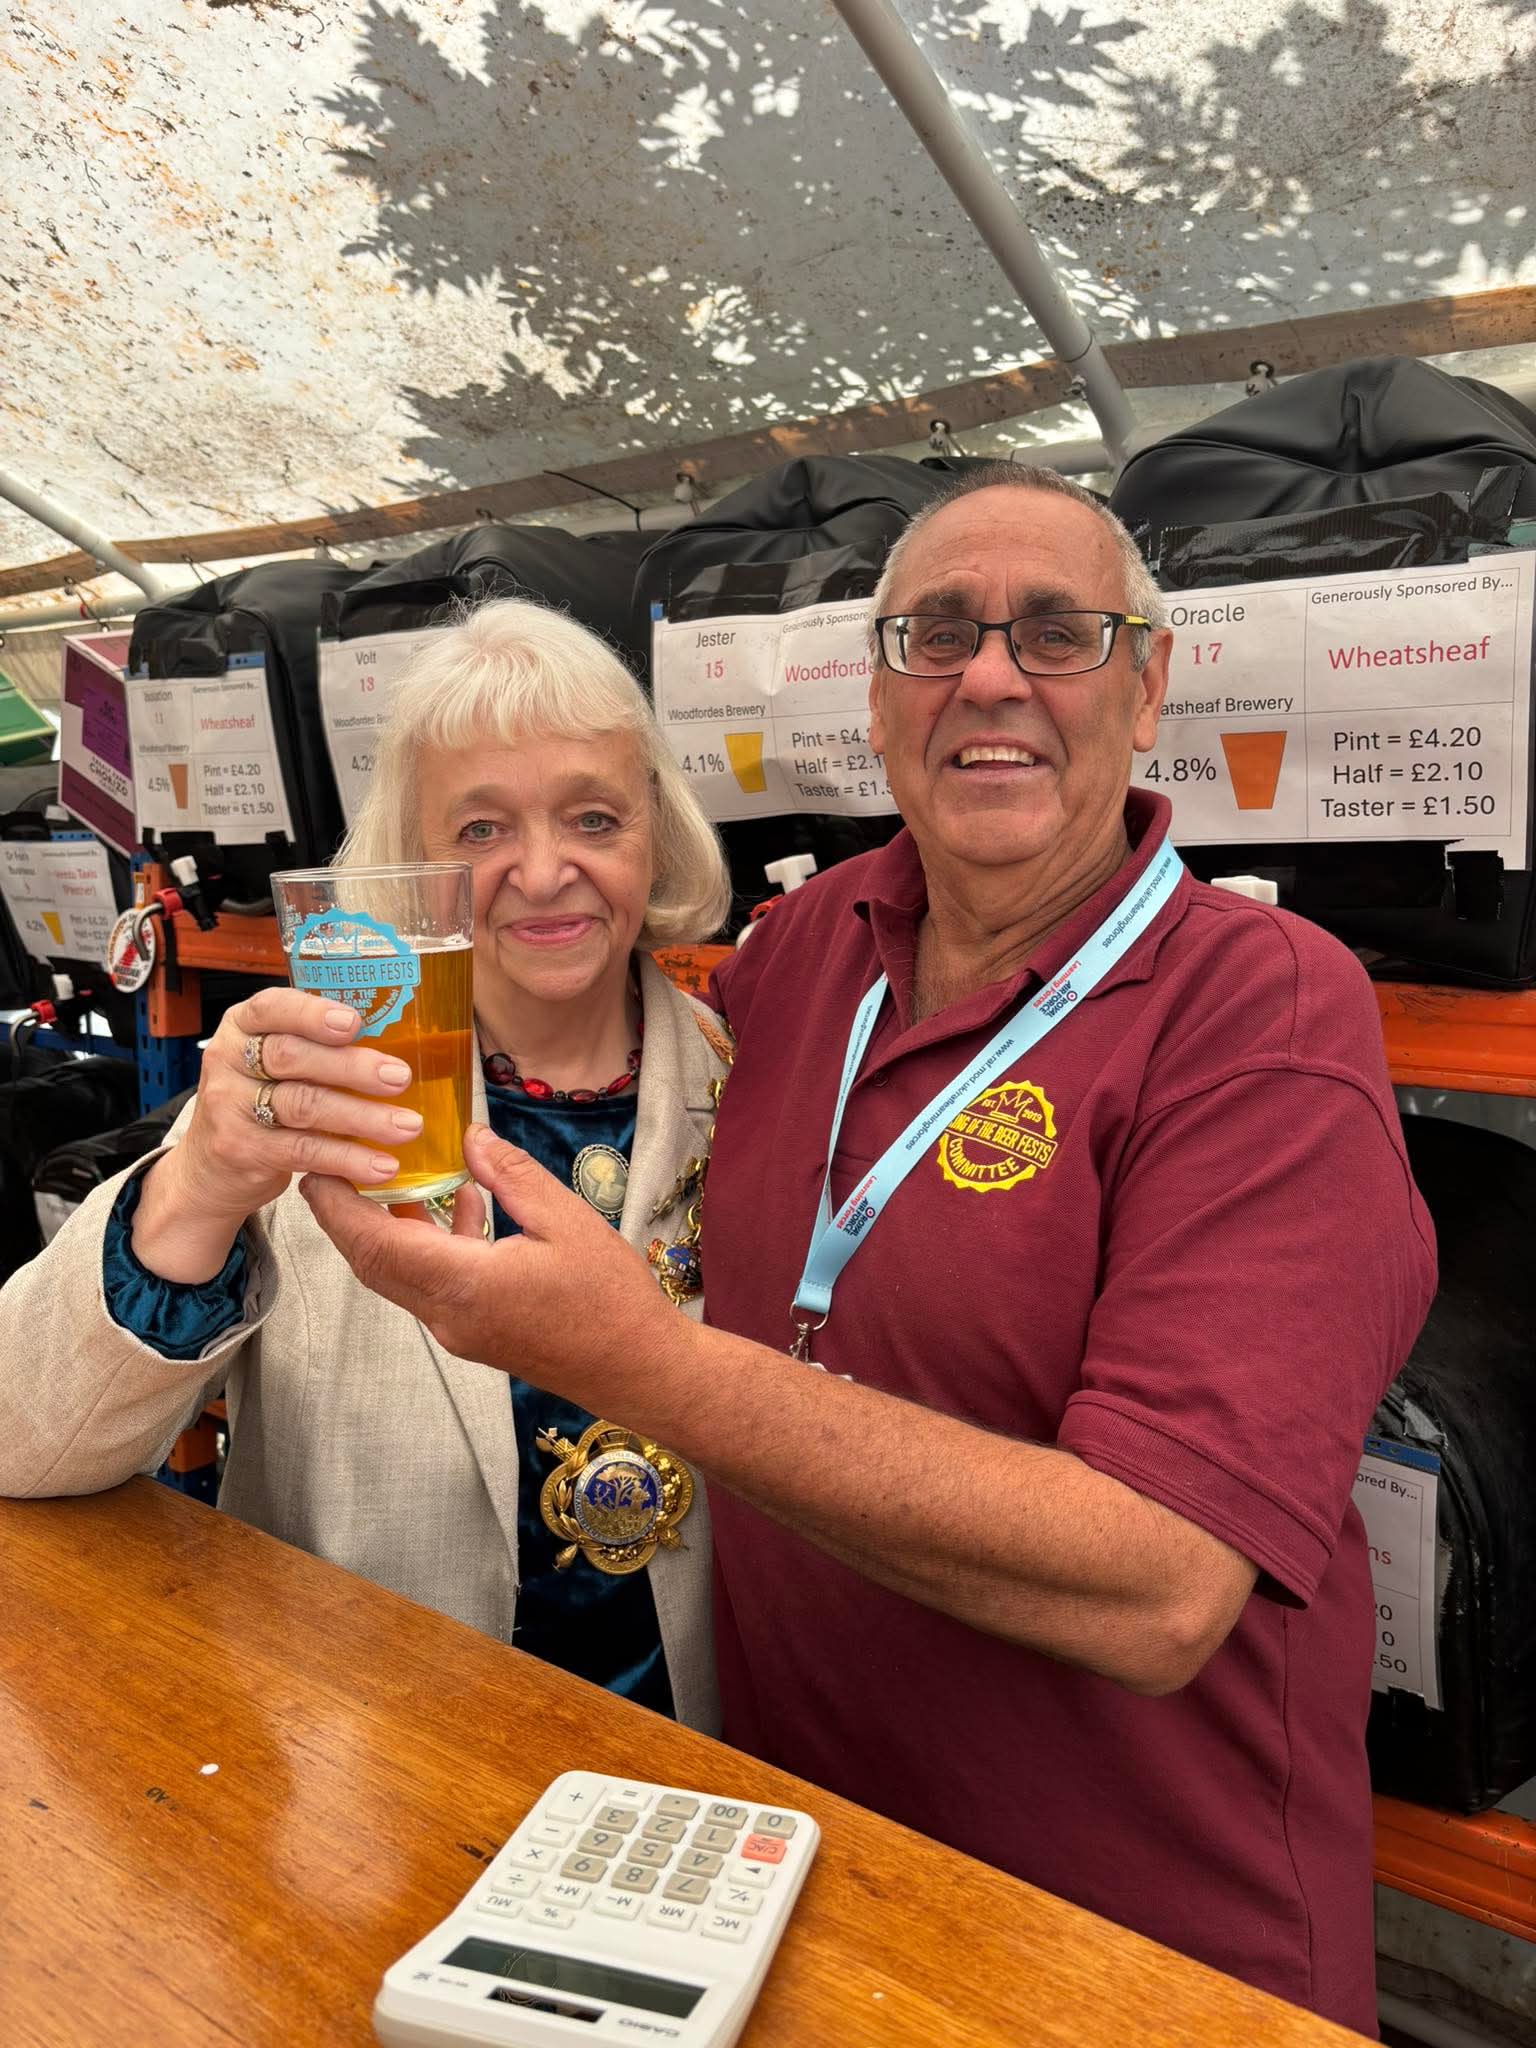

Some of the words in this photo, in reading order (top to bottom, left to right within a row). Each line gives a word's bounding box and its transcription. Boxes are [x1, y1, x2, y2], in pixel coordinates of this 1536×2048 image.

[1311, 586, 1393, 606] Generously
[1396, 577, 1477, 598] Sponsored
[1480, 575, 1514, 592] By...
[1170, 603, 1246, 627] Oracle
[782, 615, 825, 635] Generously
[695, 630, 736, 649] Jester
[355, 651, 377, 665] Volt
[1191, 642, 1224, 666] 17
[1327, 635, 1491, 670] Wheatsheaf
[704, 660, 724, 679] 15
[785, 656, 876, 684] Woodforde
[667, 706, 724, 722] Woodfordes
[725, 703, 766, 718] Brewery
[1160, 699, 1222, 717] atsheaf
[1225, 695, 1294, 713] Brewery
[200, 714, 256, 731] Wheatsheaf
[791, 731, 824, 749] Pint
[1333, 730, 1381, 751] Pint
[1408, 726, 1482, 748] £4.20
[203, 765, 222, 777] Pint
[230, 763, 261, 777] £4.20
[681, 752, 725, 774] 4.1%
[794, 757, 828, 776] Half
[846, 754, 883, 772] £2.1
[1144, 757, 1217, 783] 4.8%
[1332, 764, 1384, 785] Half
[1411, 761, 1484, 783] £2.10
[204, 784, 224, 796] Half
[234, 783, 265, 796] £2.10
[794, 782, 840, 798] Taster
[202, 804, 231, 816] Taster
[241, 802, 275, 816] £1.50
[1320, 797, 1396, 819] Taster
[1422, 795, 1496, 816] £1.50
[310, 966, 323, 983] OF
[326, 965, 345, 983] THE
[347, 963, 376, 982] BEER
[380, 961, 414, 980] FESTS
[1053, 960, 1082, 989] Learning
[343, 989, 357, 999] OF
[359, 989, 377, 999] THE
[1032, 985, 1057, 1009] Forces
[1060, 980, 1072, 996] AIR
[1039, 992, 1063, 1016] FORCE
[1046, 999, 1069, 1018] ROYAL
[905, 1038, 1015, 1151] www.raf.mod.uk/raflearningforces
[966, 1117, 983, 1135] OF
[977, 1120, 998, 1140] THE
[992, 1124, 1020, 1150] BEER
[1016, 1134, 1053, 1163] FESTS
[949, 1137, 1020, 1179] COMMITTEE
[850, 1175, 877, 1205] Learning
[857, 1197, 869, 1214] AIR
[836, 1201, 856, 1230] Forces
[843, 1208, 862, 1234] FORCE
[850, 1215, 868, 1237] ROYAL
[607, 1809, 625, 1823] 3
[713, 1804, 738, 1819] 00
[655, 1818, 673, 1833] 2
[767, 1815, 783, 1828] 0
[593, 1832, 609, 1847] 6
[707, 1829, 716, 1841] 1
[643, 1842, 659, 1857] 5
[749, 1842, 777, 1855] C/AC
[574, 1858, 591, 1873] 9
[693, 1853, 710, 1866] 4
[625, 1867, 644, 1882] 8
[554, 1884, 580, 1897] M+
[677, 1878, 694, 1892] 7
[487, 1895, 513, 1907] MU
[544, 1907, 559, 1918] %
[659, 1904, 685, 1918] MR
[713, 1916, 740, 1930] MC
[617, 2017, 681, 2038] CASIO
